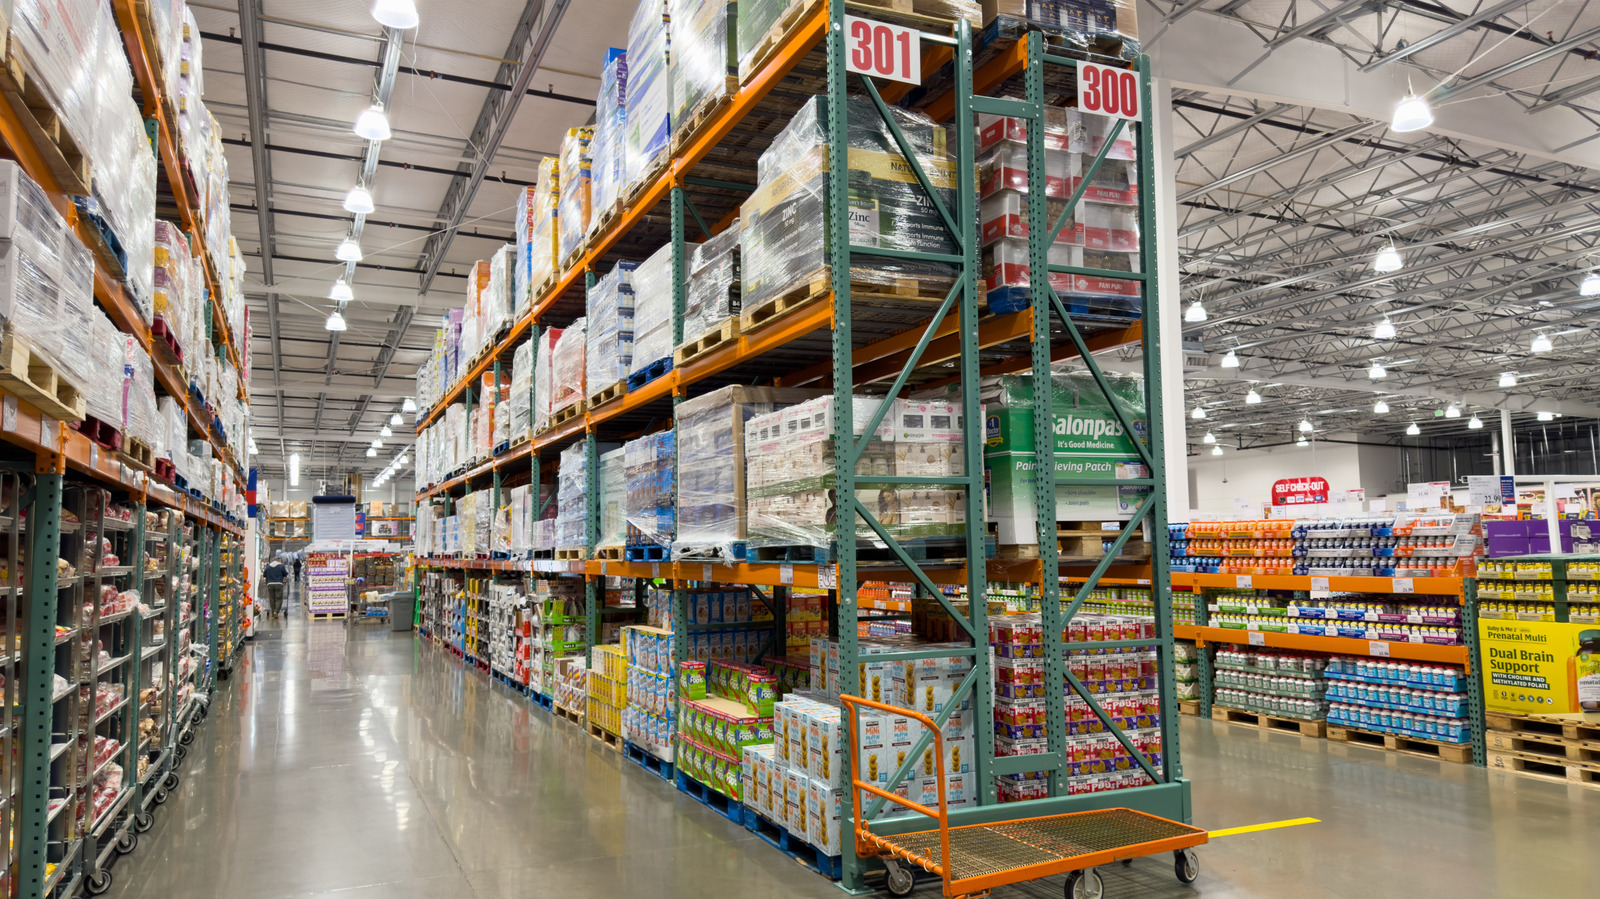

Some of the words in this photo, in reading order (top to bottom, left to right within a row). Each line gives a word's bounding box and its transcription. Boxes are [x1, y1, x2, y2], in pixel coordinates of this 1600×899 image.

[850, 20, 911, 79] 301
[1082, 64, 1138, 117] 300
[916, 195, 934, 208] ZIN
[782, 202, 796, 222] ZINC
[849, 211, 870, 222] Zinc
[922, 233, 944, 241] Immune
[1086, 441, 1115, 449] Medicine.
[1054, 462, 1082, 474] ieving
[1085, 462, 1112, 471] Patch
[1275, 484, 1289, 493] SELF
[1290, 482, 1324, 492] CHECK-OUT
[1488, 632, 1522, 640] Prenatal
[1525, 634, 1547, 642] Multi
[1490, 648, 1517, 659] Dual
[1520, 650, 1554, 662] Brain
[1491, 659, 1540, 673] Support
[1493, 679, 1527, 687] METHYLATED
